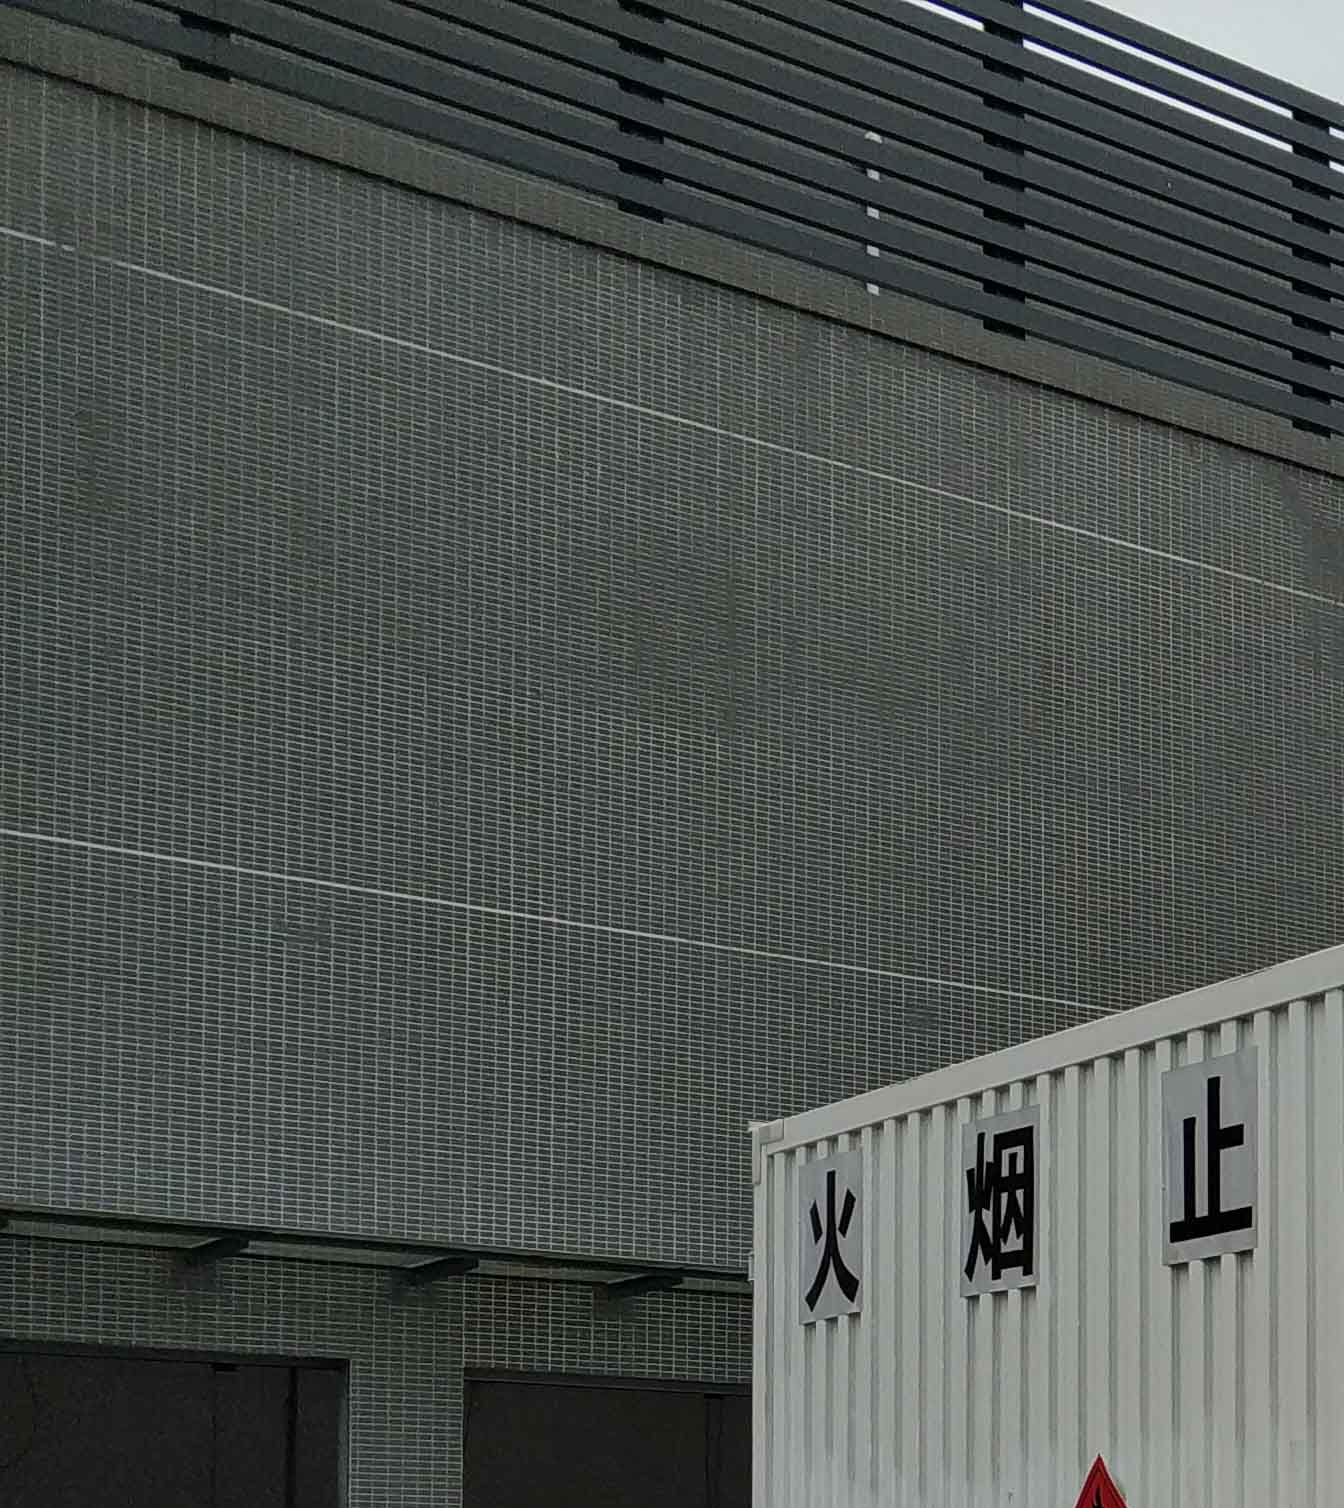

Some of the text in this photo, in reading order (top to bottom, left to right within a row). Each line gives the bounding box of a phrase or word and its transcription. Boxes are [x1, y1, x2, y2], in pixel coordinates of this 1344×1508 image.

[965, 1123, 1036, 1281] 烟
[1168, 1076, 1253, 1244] 止
[804, 1170, 860, 1313] 火
